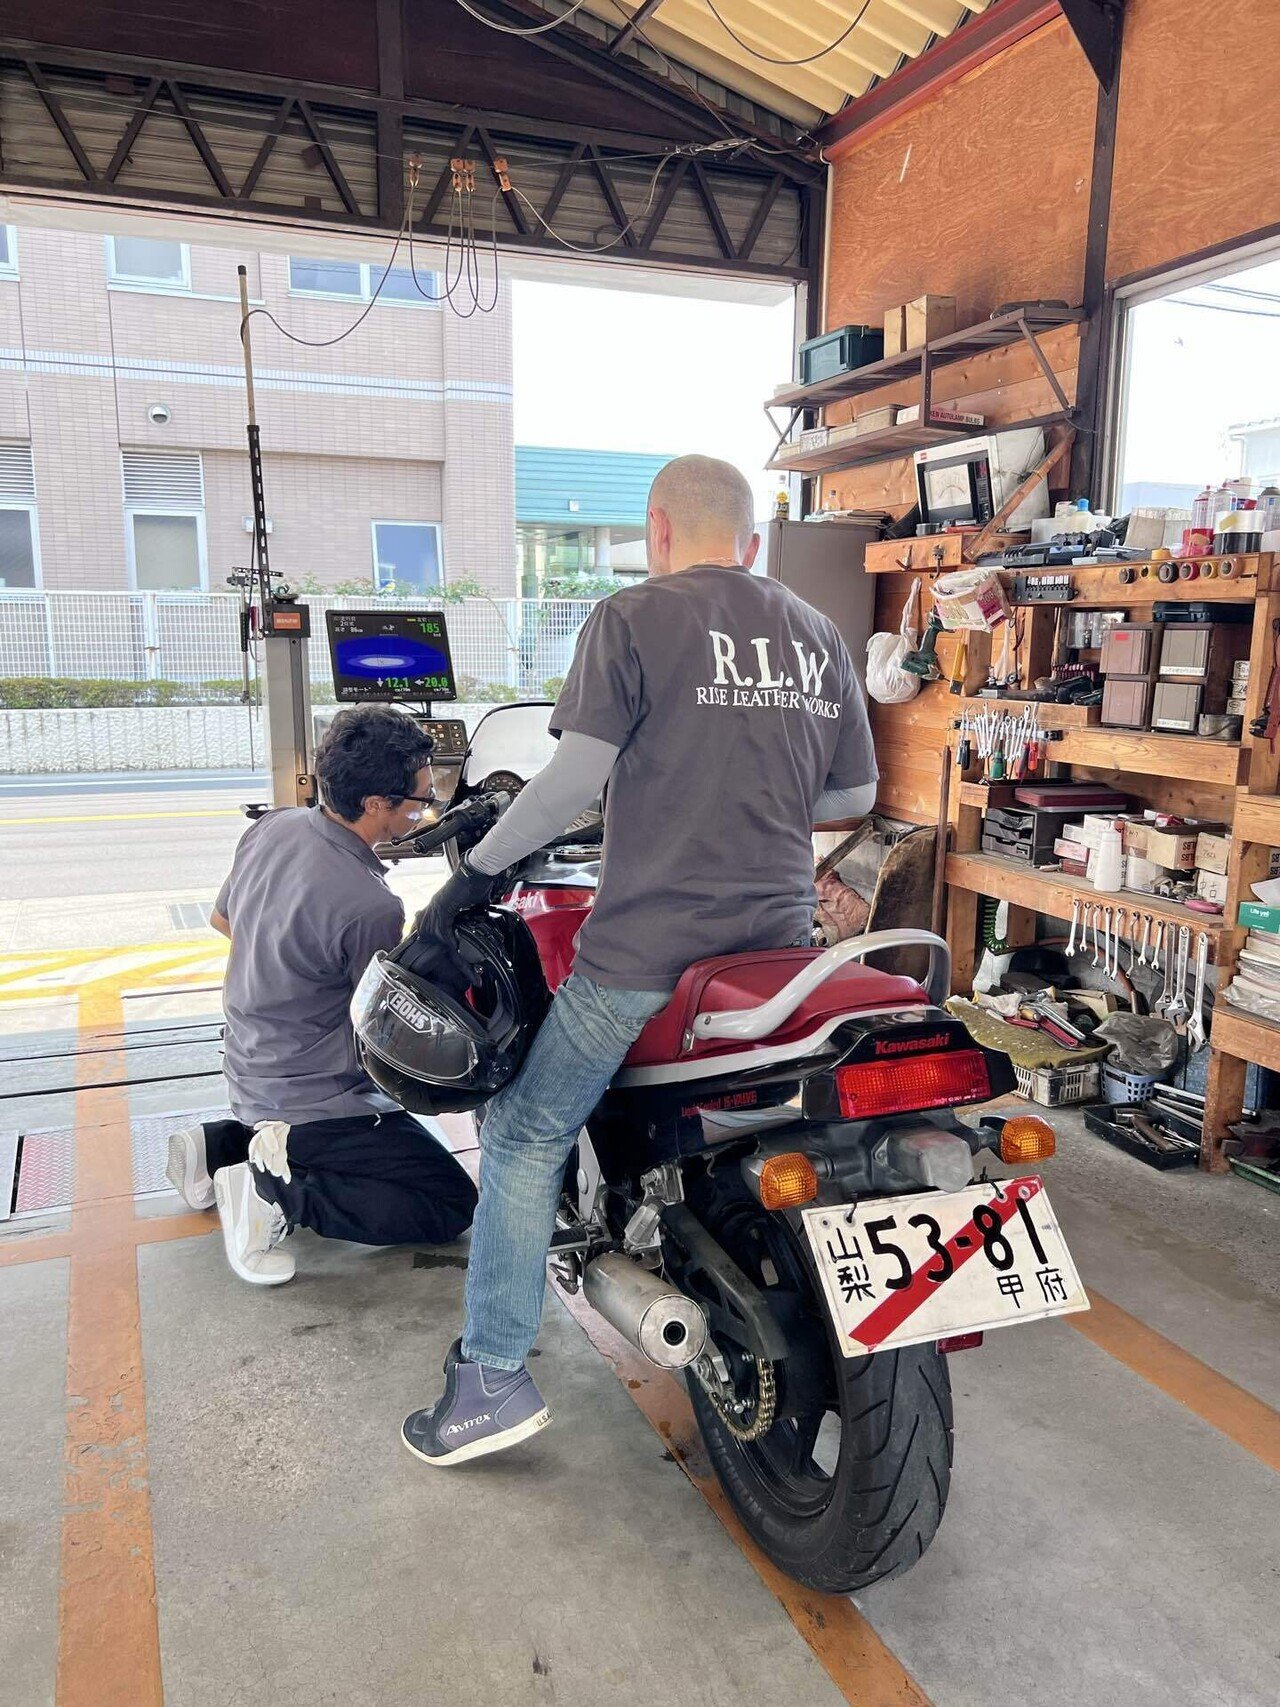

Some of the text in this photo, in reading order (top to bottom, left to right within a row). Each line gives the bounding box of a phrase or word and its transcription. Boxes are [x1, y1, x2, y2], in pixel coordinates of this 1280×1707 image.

[420, 622, 440, 633] 185
[709, 630, 829, 696] R.L.W
[385, 677, 409, 688] 12.1
[696, 686, 841, 719] RISE LEATHER WORKS
[390, 992, 429, 1030] SHOEI
[875, 1032, 950, 1055] Kawasaki
[863, 1198, 1049, 1290] 53-81
[827, 1228, 876, 1303] 山梨
[996, 1267, 1068, 1309] 甲府
